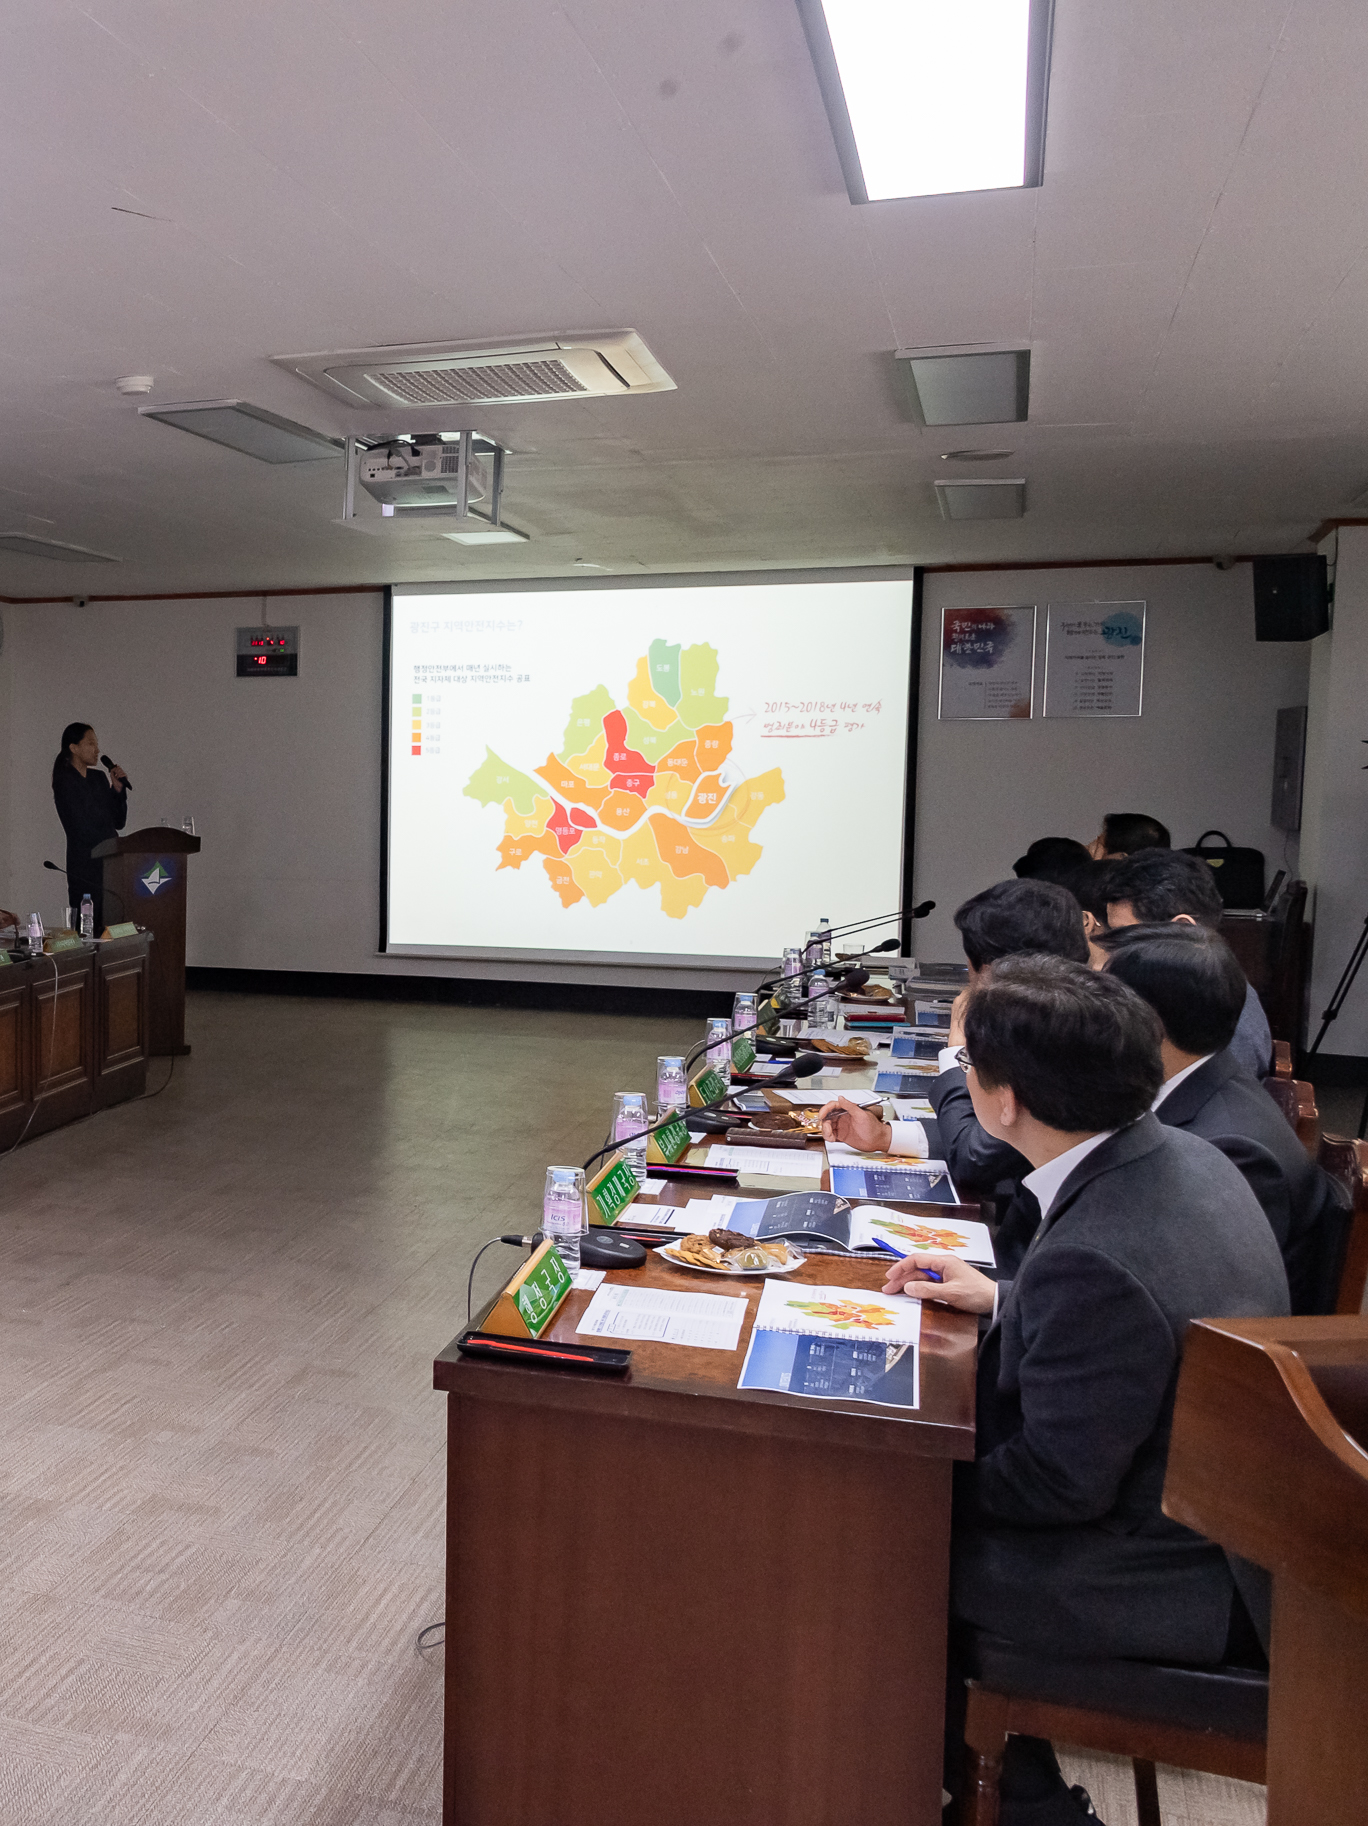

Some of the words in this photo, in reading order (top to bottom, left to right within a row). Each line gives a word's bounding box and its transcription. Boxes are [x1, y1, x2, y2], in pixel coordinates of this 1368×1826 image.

[410, 621, 440, 634] 광진구
[443, 619, 524, 633] 지역안전지수는?
[950, 641, 994, 654] 대한민국
[413, 664, 464, 673] 행정안전부에서
[466, 664, 481, 673] 매년
[483, 664, 512, 672] 실시하는
[656, 664, 670, 672] 도봉
[413, 675, 428, 684] 전국
[430, 675, 452, 684] 지자체
[453, 675, 467, 684] 대상
[470, 674, 514, 683] 지역안전지수
[516, 674, 531, 683] 공표
[690, 688, 705, 696] 노원
[764, 701, 836, 713] 2015~2018년
[839, 702, 858, 713] 4년
[862, 699, 883, 715] 연속
[576, 718, 590, 727] 은평
[763, 720, 805, 733] 범죄분야
[809, 718, 839, 733] 4등급
[843, 722, 866, 732] 평가
[643, 736, 657, 745] 성북
[704, 740, 719, 748] 중랑
[613, 753, 627, 761] 종로
[667, 758, 688, 767] 동대문
[579, 763, 600, 771] 서대문
[496, 775, 510, 784] 강서
[626, 779, 640, 787] 중구
[560, 780, 575, 788] 마포
[697, 793, 717, 804] 광진
[616, 808, 630, 816] 용산
[555, 827, 576, 835] 영등포
[509, 848, 522, 856] 구로
[675, 846, 689, 854] 강남
[636, 858, 649, 866] 서초
[556, 876, 569, 884] 금천
[596, 1163, 635, 1219] 기획경제국장
[550, 1213, 566, 1221] ICIS
